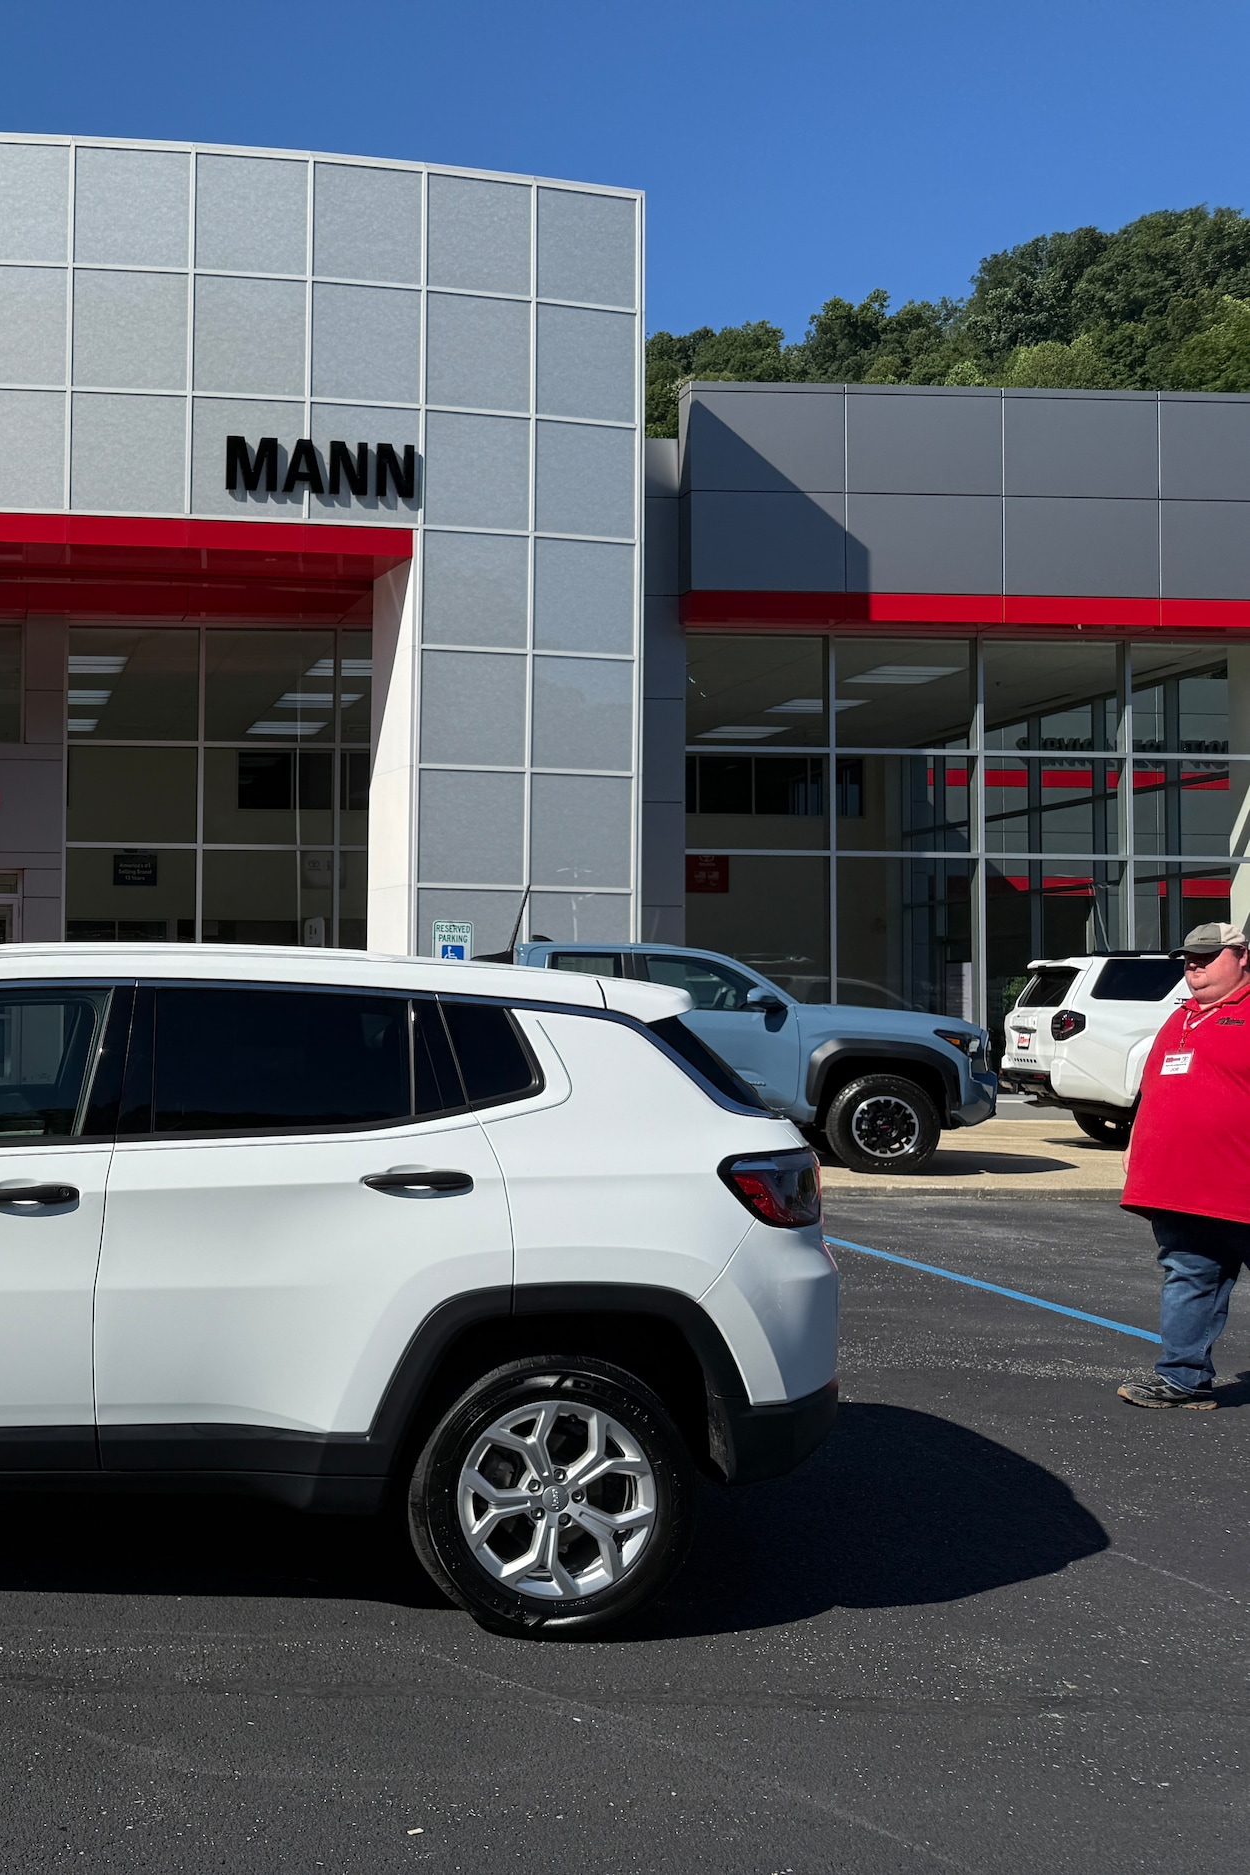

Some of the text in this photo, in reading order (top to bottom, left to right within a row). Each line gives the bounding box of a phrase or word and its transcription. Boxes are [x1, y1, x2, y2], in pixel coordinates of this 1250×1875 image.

[225, 435, 416, 499] MANN
[436, 924, 471, 934] RESERVED
[438, 934, 468, 943] PARKING
